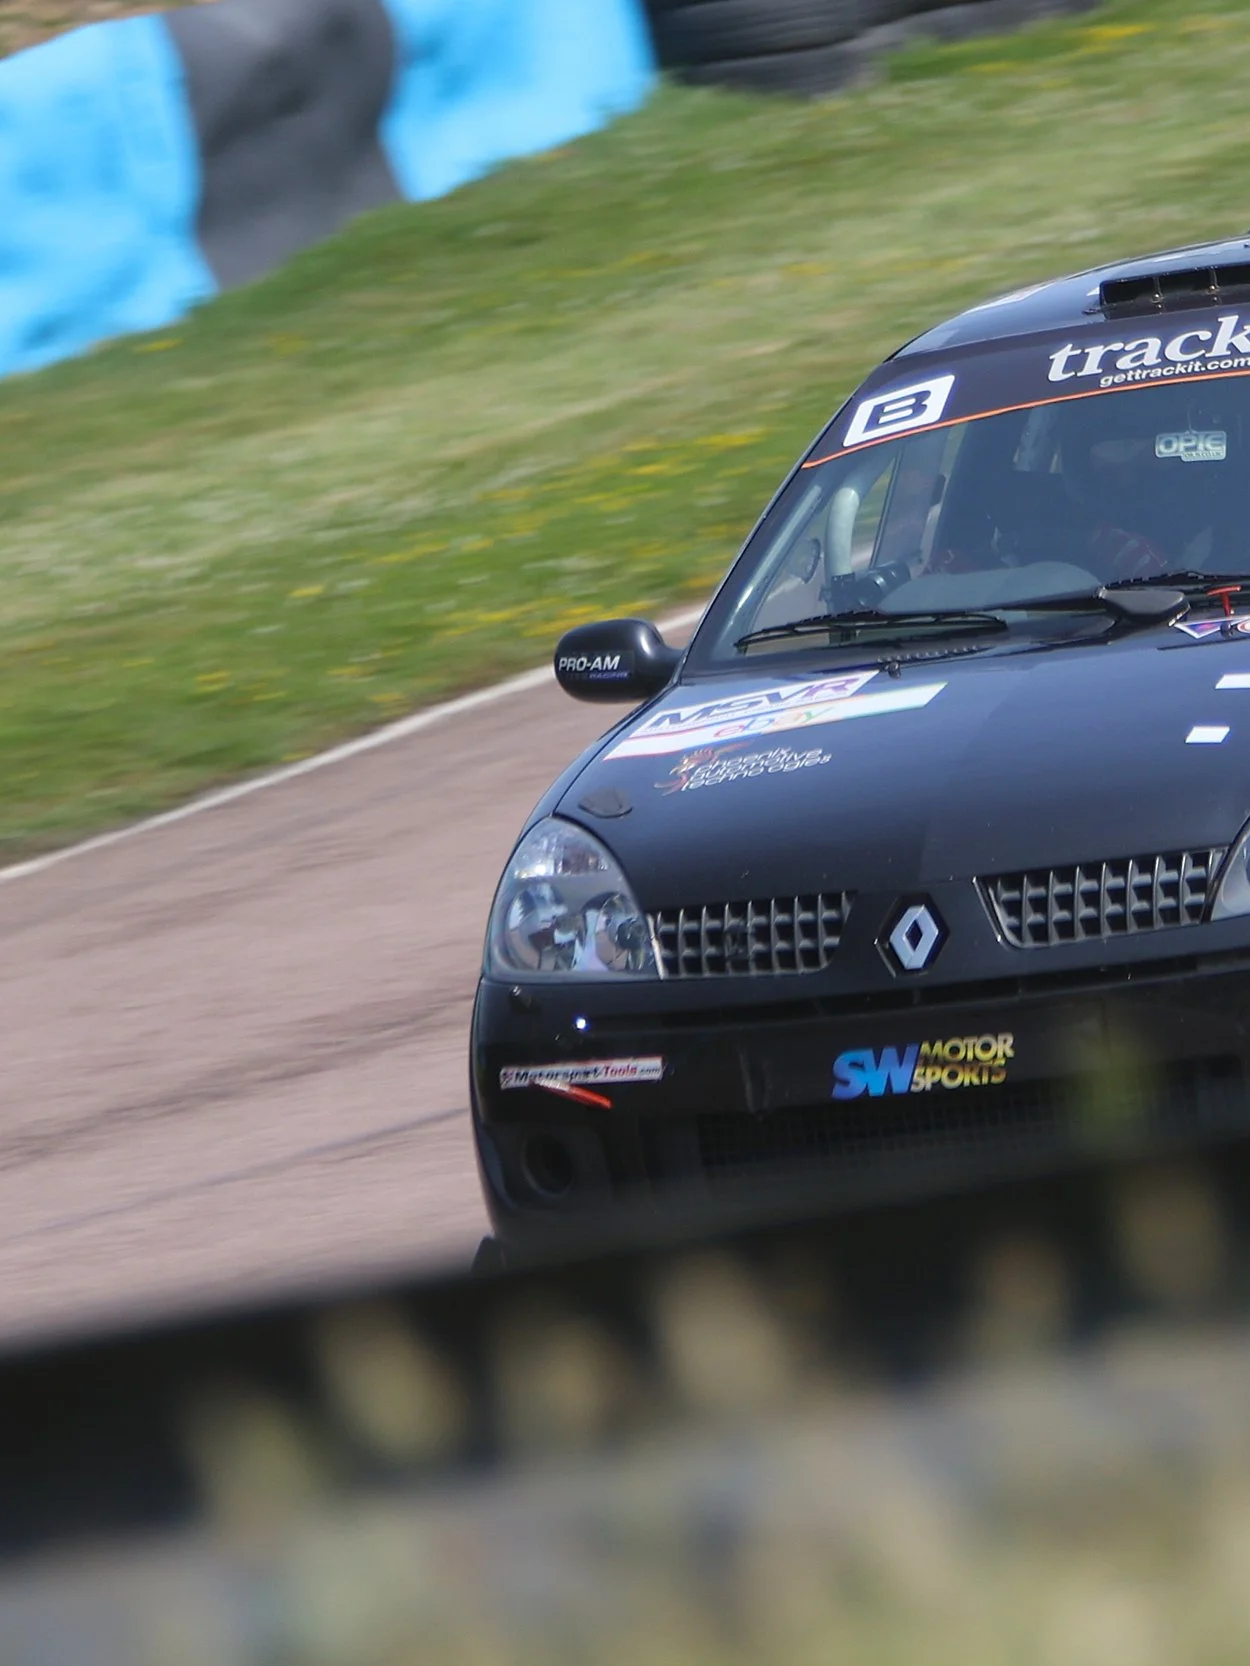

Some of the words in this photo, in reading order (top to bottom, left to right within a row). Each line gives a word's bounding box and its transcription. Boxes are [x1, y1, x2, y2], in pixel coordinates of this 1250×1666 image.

[558, 655, 621, 671] PRO-AM
[649, 678, 860, 728] MSVR
[919, 1032, 1015, 1063] MOTOR
[832, 1045, 920, 1100] SW
[911, 1058, 1007, 1093] SPORTS
